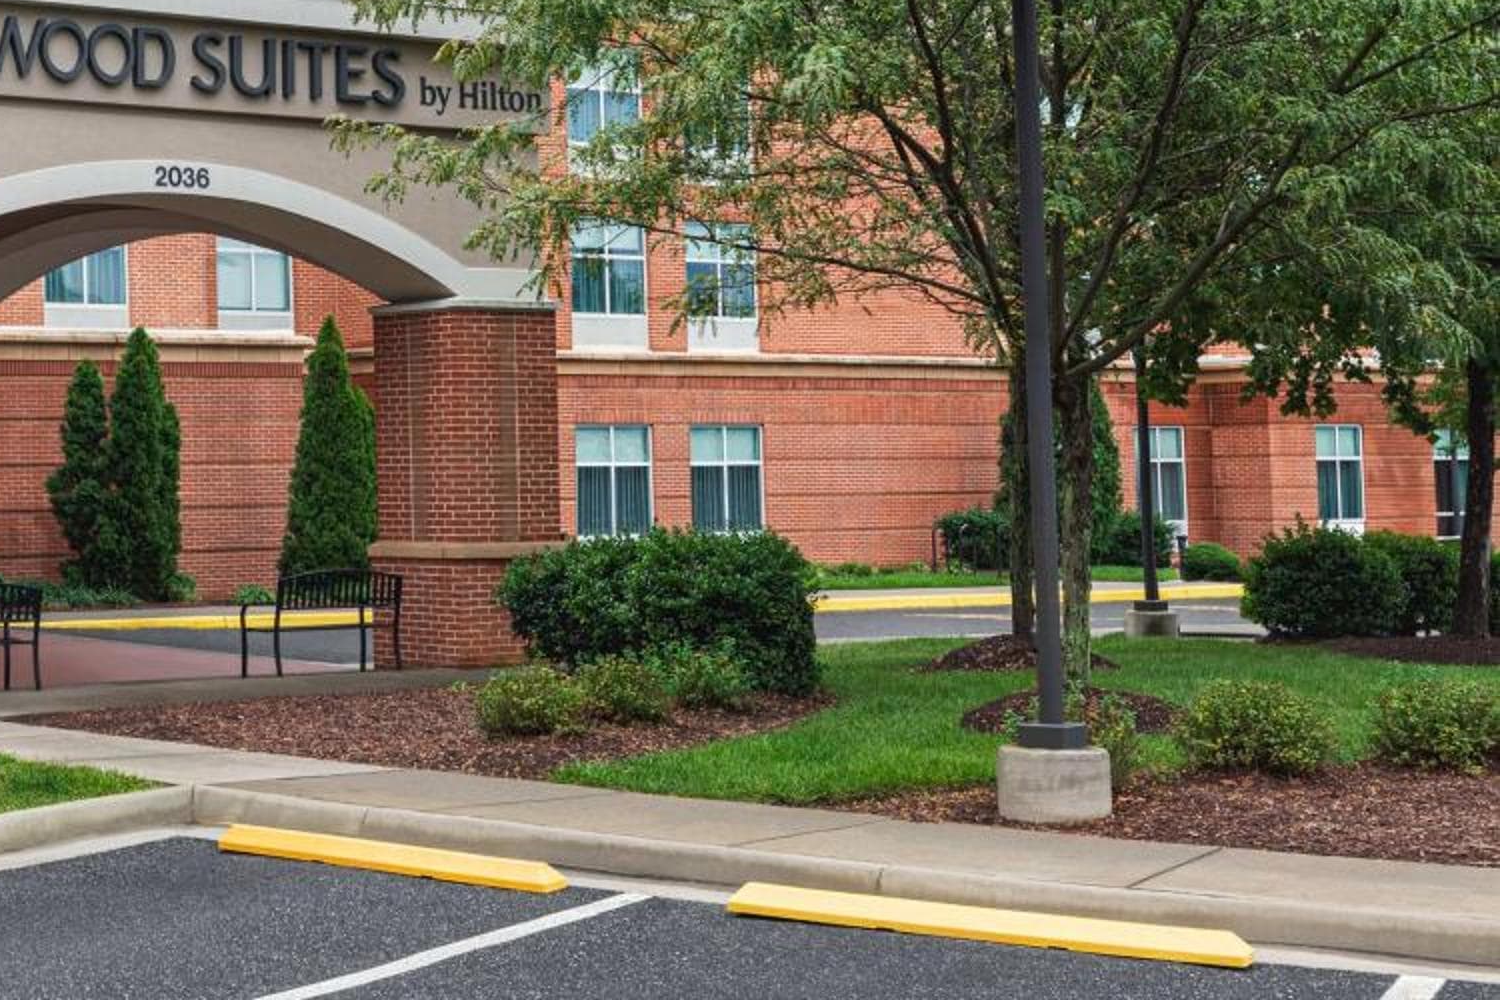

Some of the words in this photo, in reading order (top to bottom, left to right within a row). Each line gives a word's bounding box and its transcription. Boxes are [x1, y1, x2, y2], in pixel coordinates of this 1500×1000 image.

[190, 35, 405, 107] SUITES
[419, 76, 452, 115] by
[458, 80, 542, 113] Hilton
[155, 166, 210, 189] 2036
